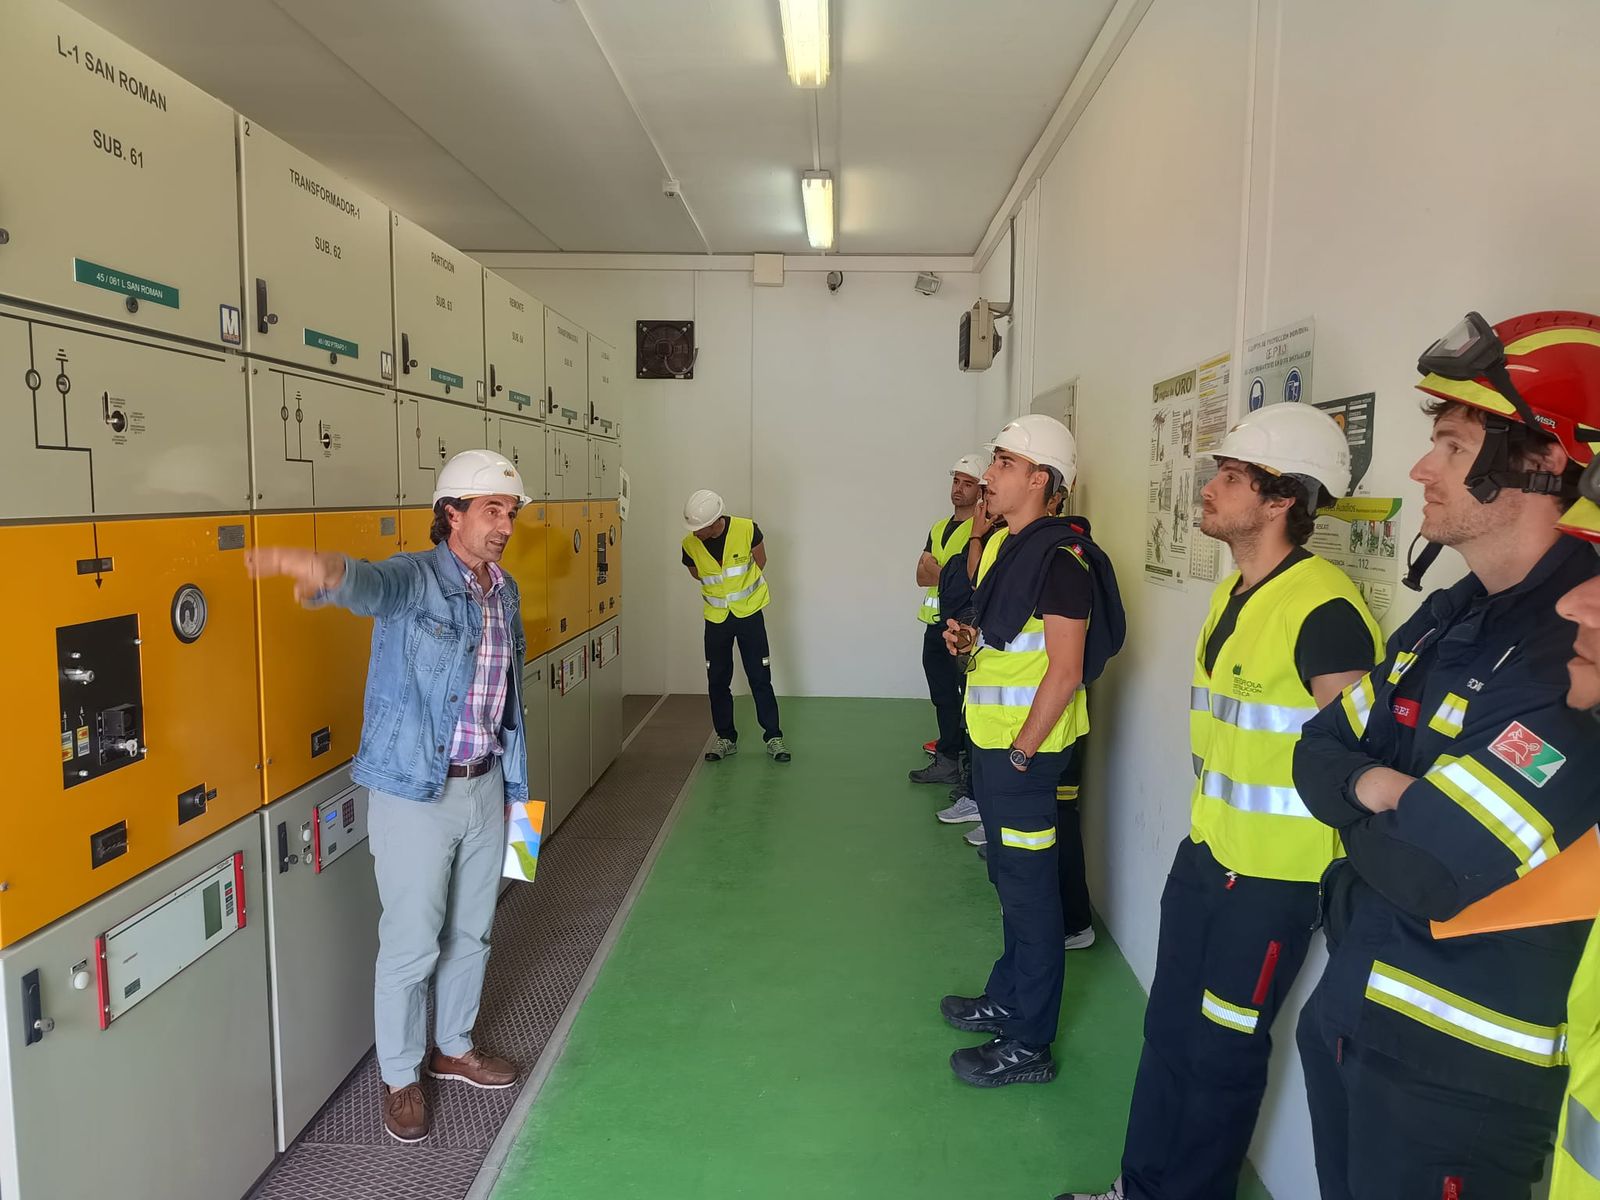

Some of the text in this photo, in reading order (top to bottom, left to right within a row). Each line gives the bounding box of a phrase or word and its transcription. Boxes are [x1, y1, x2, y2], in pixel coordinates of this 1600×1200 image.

[57, 34, 167, 113] L-1 SAN ROMAN
[244, 121, 251, 137] 2
[93, 128, 144, 169] SUB. 61
[289, 168, 361, 221] TRANSFORMADOR-1
[314, 236, 342, 260] SUB. 62
[127, 281, 140, 292] SAN
[140, 285, 163, 298] ROMAN
[1175, 376, 1193, 397] ORO
[1358, 557, 1369, 570] 112
